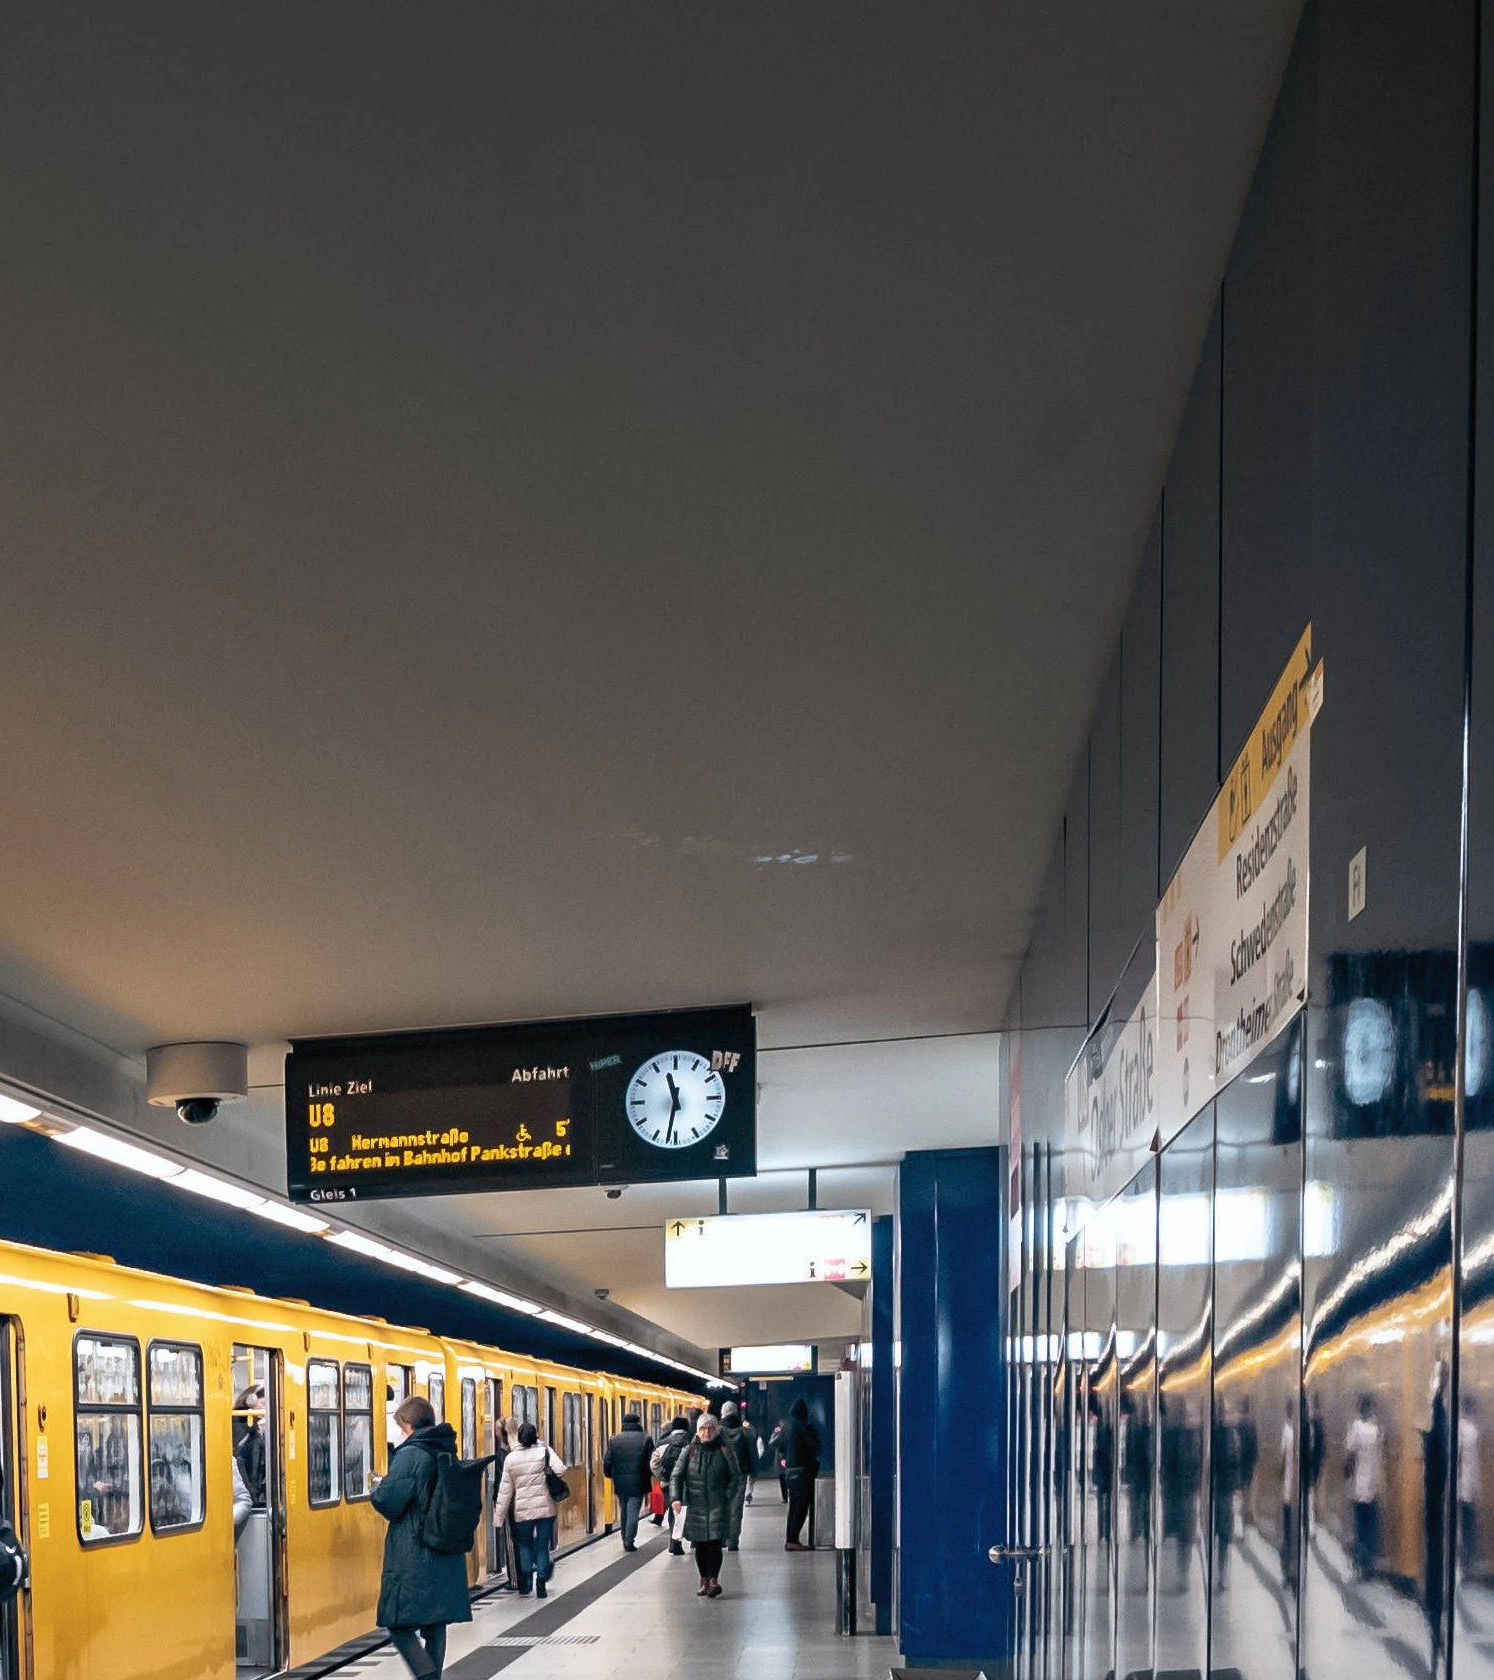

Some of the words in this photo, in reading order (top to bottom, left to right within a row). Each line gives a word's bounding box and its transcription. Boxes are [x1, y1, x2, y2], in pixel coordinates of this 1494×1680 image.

[1262, 680, 1298, 778] Ausgang
[1237, 766, 1297, 898] Residenzstraße
[1230, 857, 1295, 985] Schwedenstraße
[308, 1083, 342, 1098] Linie
[347, 1080, 372, 1095] Ziel
[511, 1066, 570, 1083] Abfahrt
[1119, 1004, 1154, 1149] Straße
[309, 1102, 335, 1127] U8
[309, 1136, 329, 1153] U8
[351, 1127, 469, 1151] Hermannstraße
[330, 1153, 382, 1171] fahren
[384, 1151, 400, 1167] in
[403, 1146, 467, 1166] Bahnhof
[470, 1141, 562, 1161] Pankstraße
[310, 1189, 346, 1201] Gleis
[348, 1187, 357, 1199] 1
